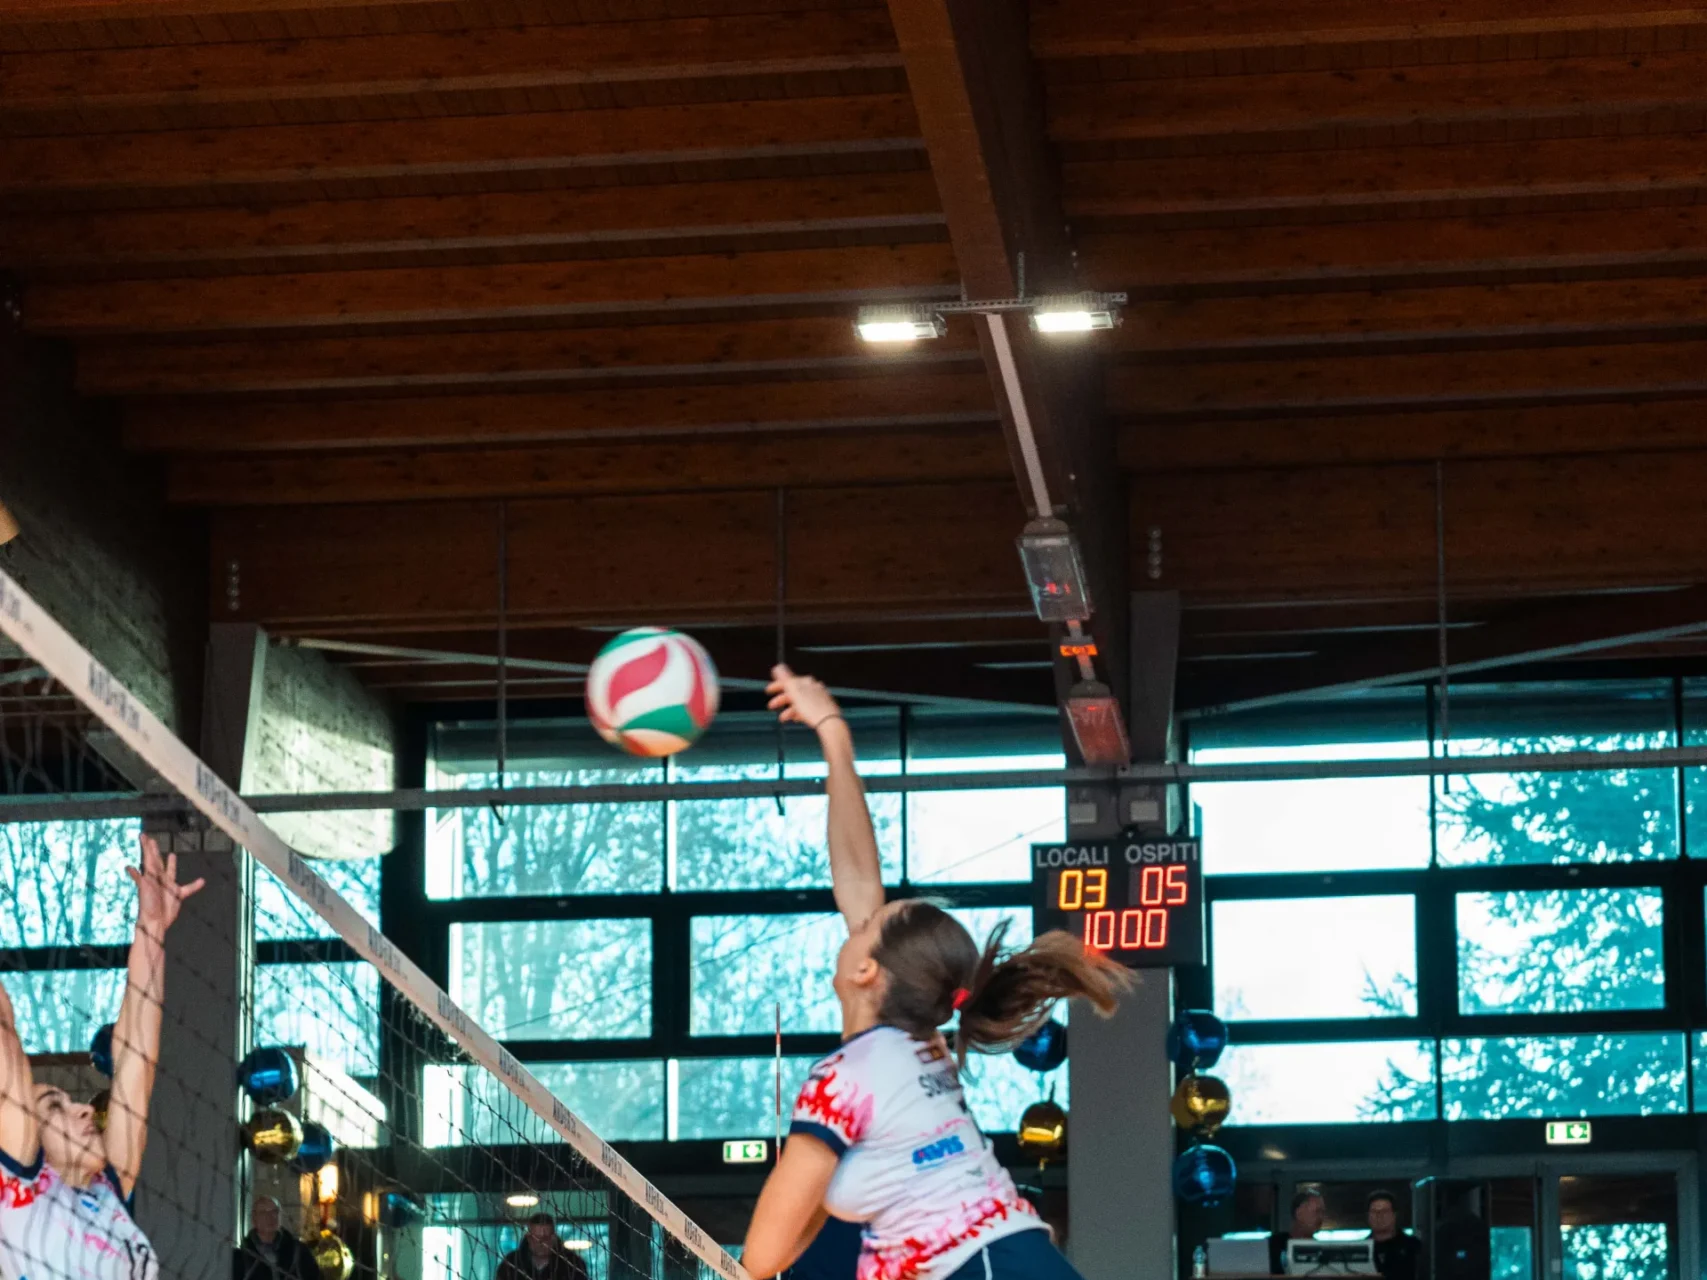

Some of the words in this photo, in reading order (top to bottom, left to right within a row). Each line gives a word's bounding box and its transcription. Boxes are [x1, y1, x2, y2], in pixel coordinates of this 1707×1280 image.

[1036, 846, 1109, 867] LOCALI
[1125, 842, 1198, 864] OSPITI
[1058, 868, 1108, 910] 03
[1140, 865, 1187, 906] 05
